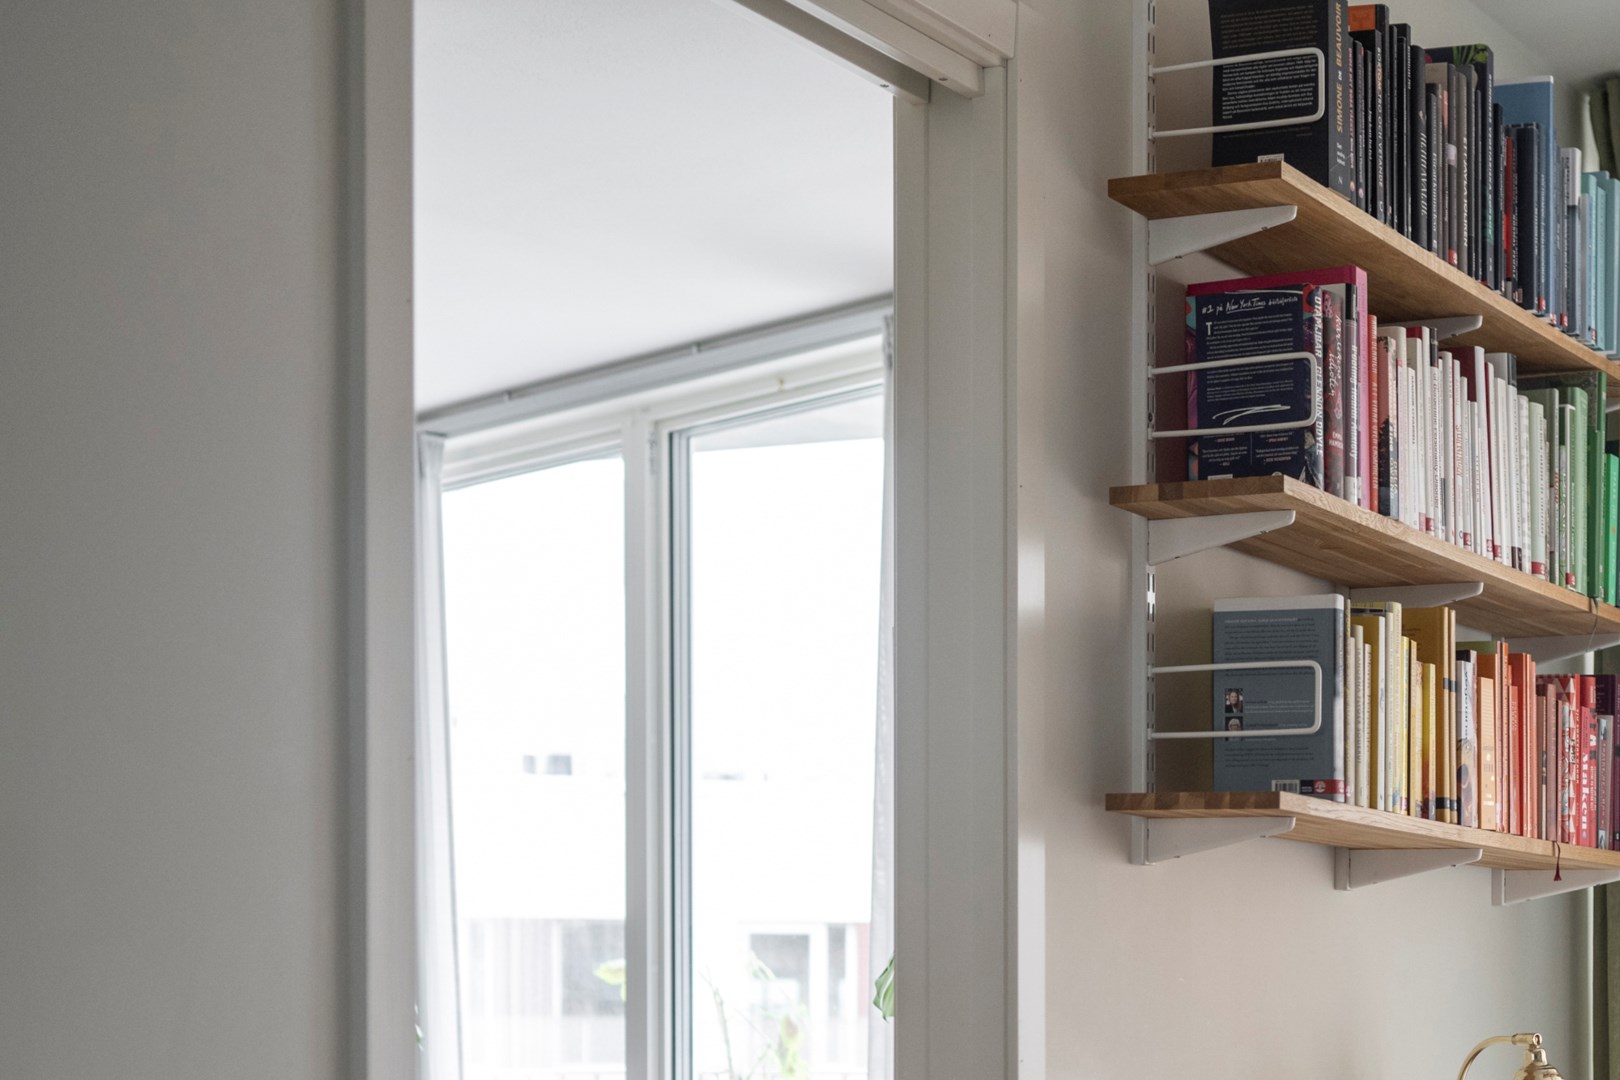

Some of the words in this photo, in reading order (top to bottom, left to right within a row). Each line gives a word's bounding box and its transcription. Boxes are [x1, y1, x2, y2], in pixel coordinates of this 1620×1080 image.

[1335, 2, 1343, 68] BEAUVOIR
[1226, 298, 1238, 312] New
[1239, 298, 1252, 309] York
[1251, 297, 1267, 308] Times
[1315, 366, 1323, 419] GLENNON
[1315, 420, 1323, 457] DOYLE
[1581, 752, 1590, 830] Maken
